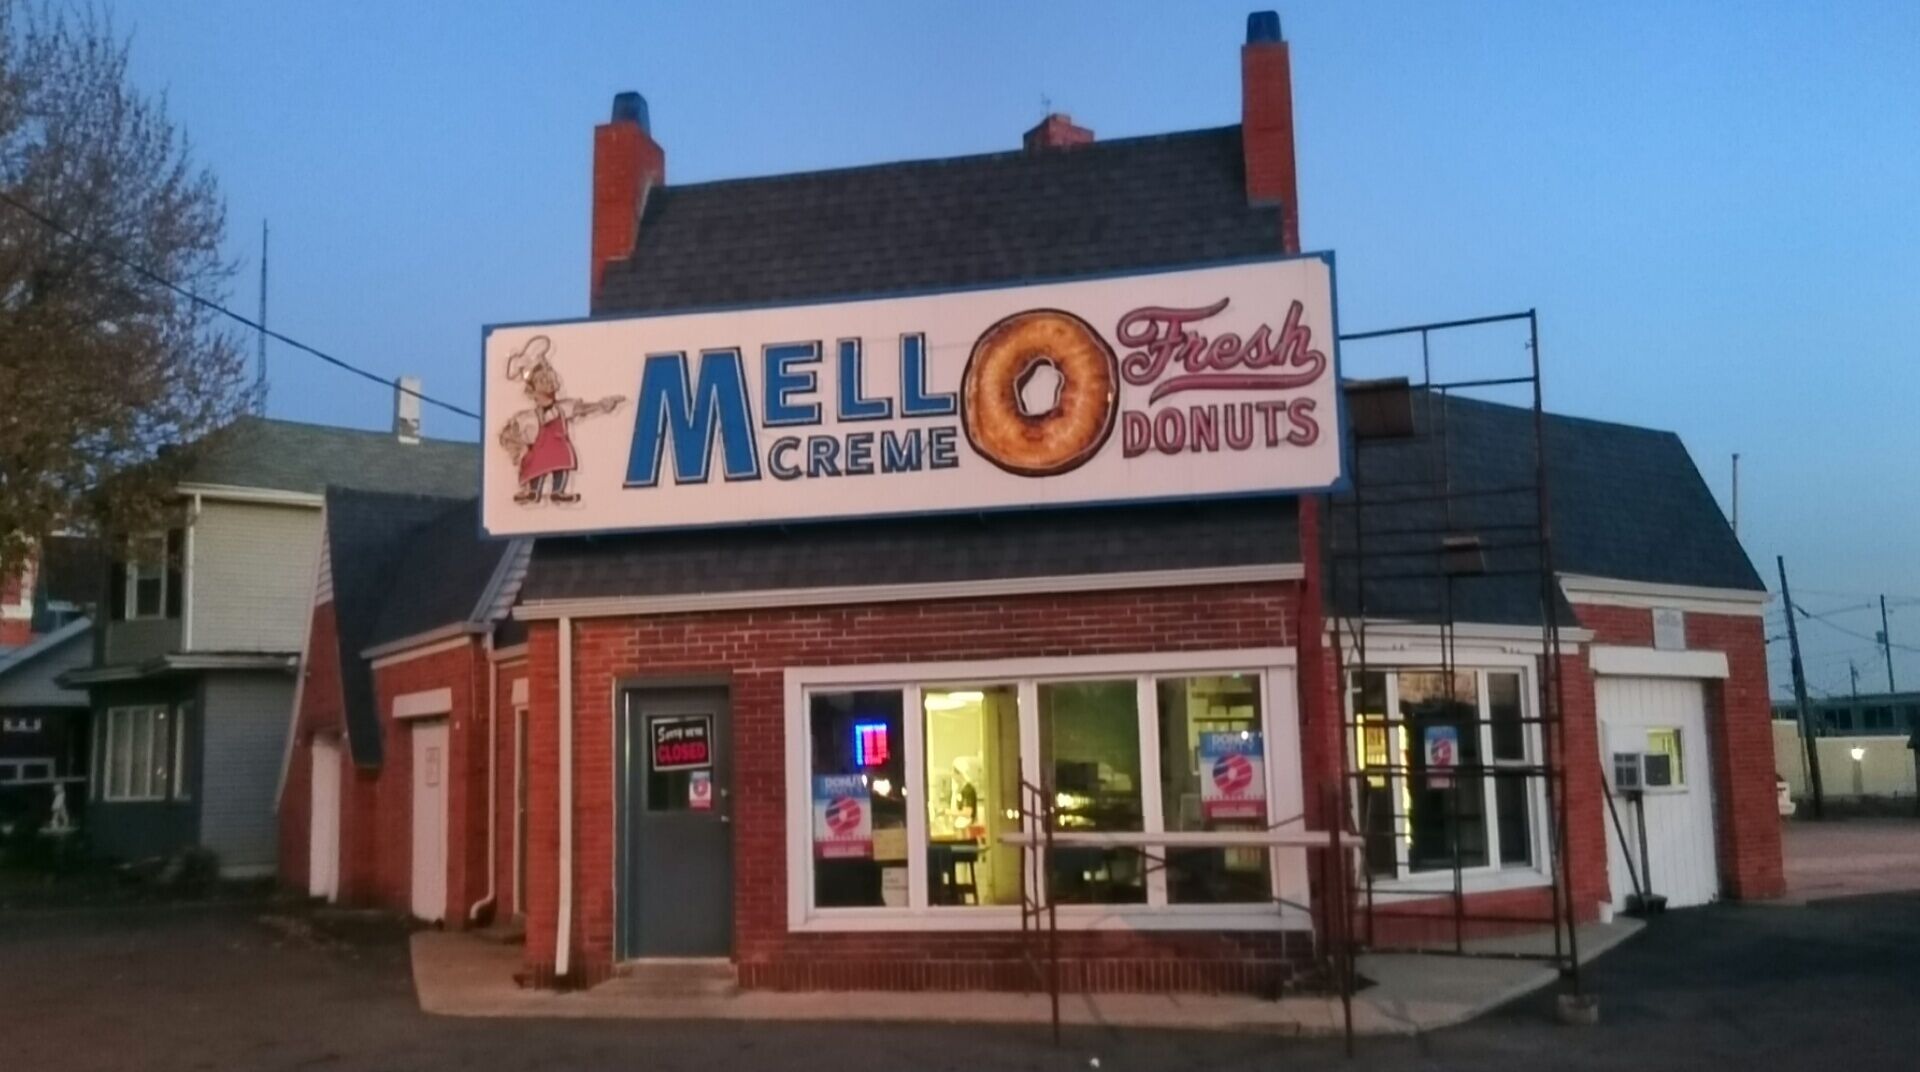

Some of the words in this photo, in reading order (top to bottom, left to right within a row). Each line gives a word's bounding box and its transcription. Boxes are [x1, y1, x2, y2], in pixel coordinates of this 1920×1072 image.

[1116, 296, 1327, 406] Fresh
[1122, 397, 1321, 460] DONUTS
[767, 426, 960, 480] CREME
[657, 726, 683, 743] Sorry
[657, 742, 706, 763] CLOSED
[1211, 734, 1256, 745] DONT
